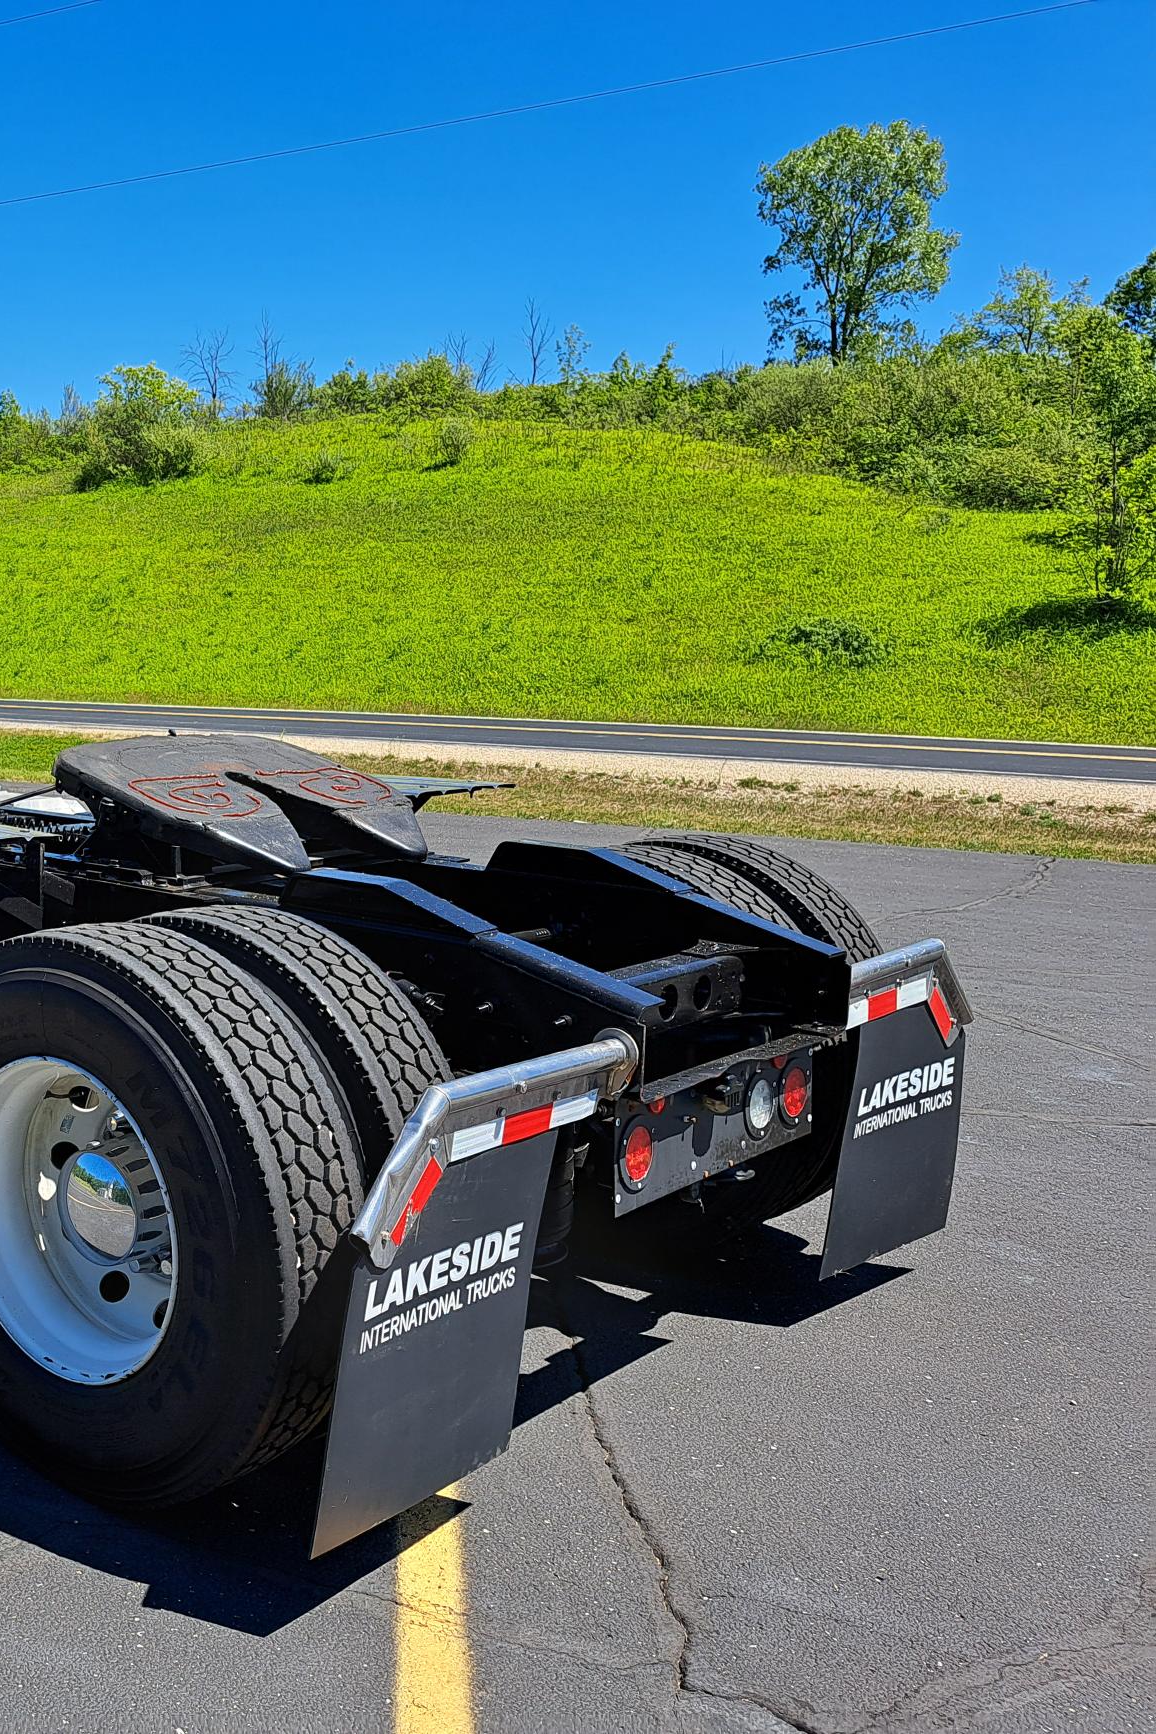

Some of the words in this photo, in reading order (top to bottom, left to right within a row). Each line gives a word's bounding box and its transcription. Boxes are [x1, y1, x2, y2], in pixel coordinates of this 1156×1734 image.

[853, 1101, 918, 1140] INTERNATIONAL
[919, 1090, 953, 1114] TRUCKS
[857, 1057, 955, 1117] LAKESIDE
[364, 1221, 525, 1322] LAKESIDE
[359, 1288, 464, 1355] INTERNATIONAL
[466, 1266, 516, 1305] TRUCKS
